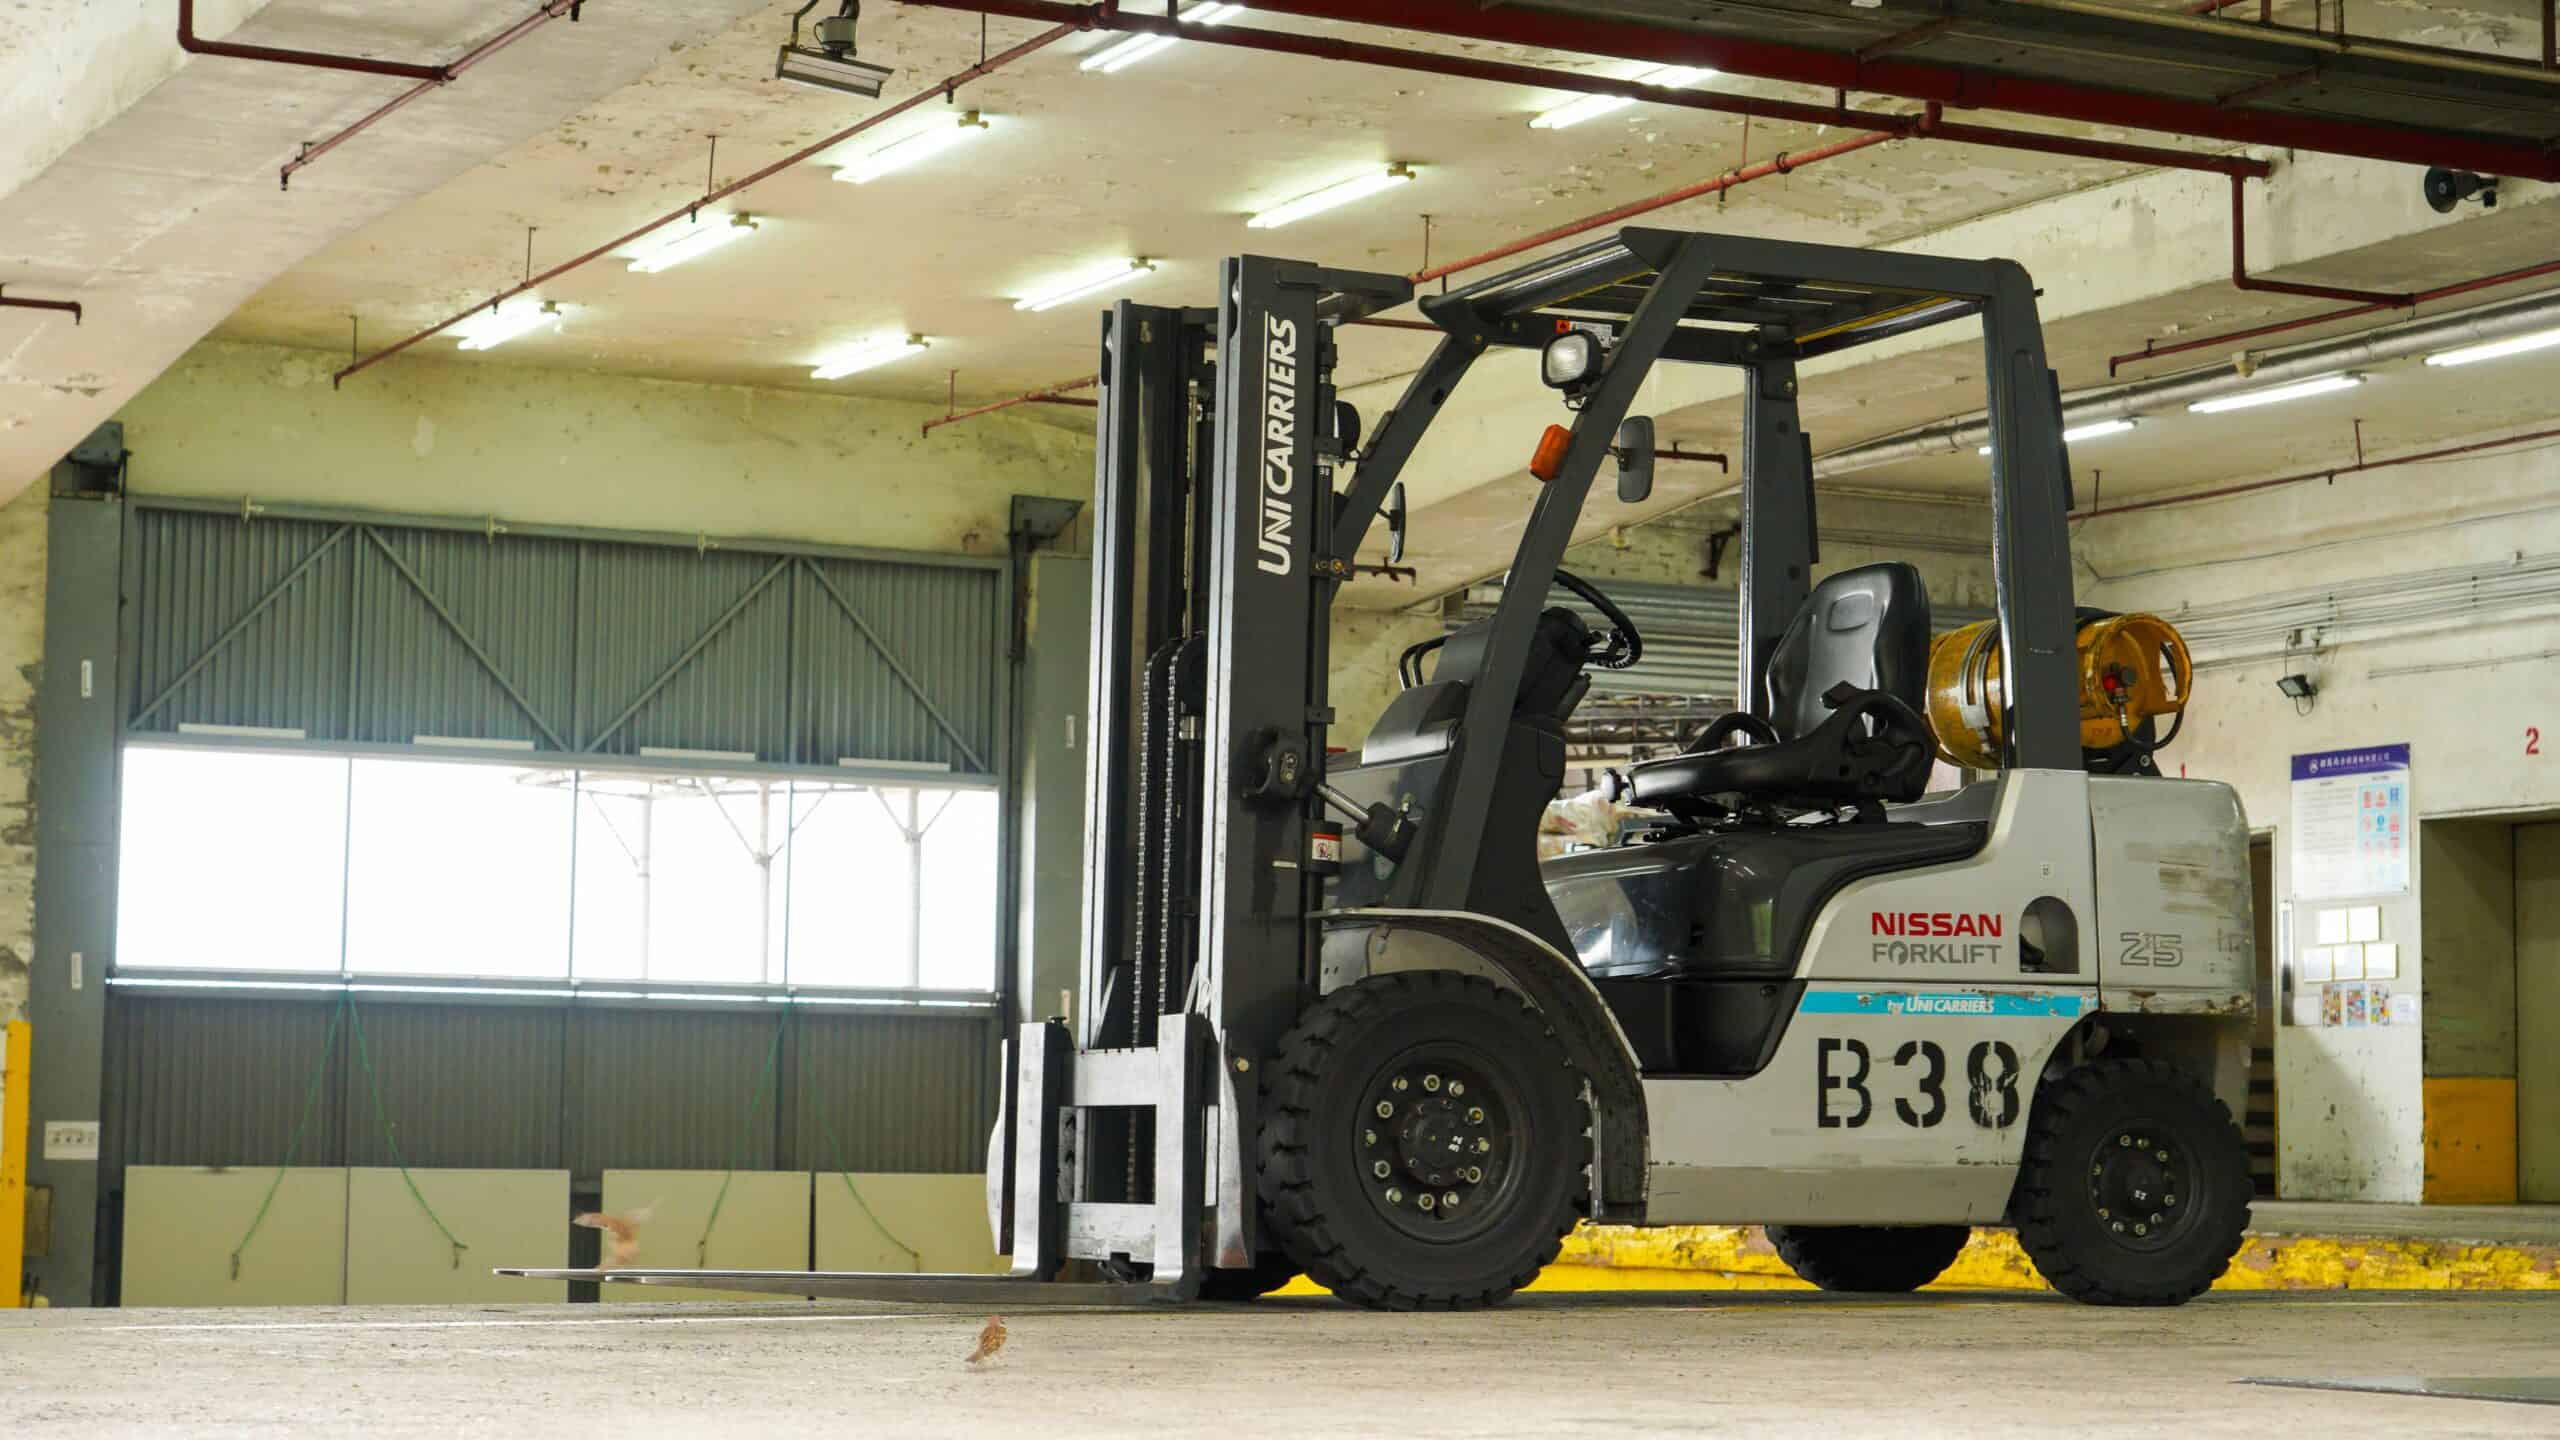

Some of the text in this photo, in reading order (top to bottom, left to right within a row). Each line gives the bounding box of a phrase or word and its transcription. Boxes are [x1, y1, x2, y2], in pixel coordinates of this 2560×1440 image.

[2525, 726, 2540, 755] 2
[1871, 912, 2002, 937] NISSAN
[1872, 940, 2003, 965] FORKLIFT
[2119, 932, 2184, 968] 25
[1816, 1038, 2020, 1129] B38
